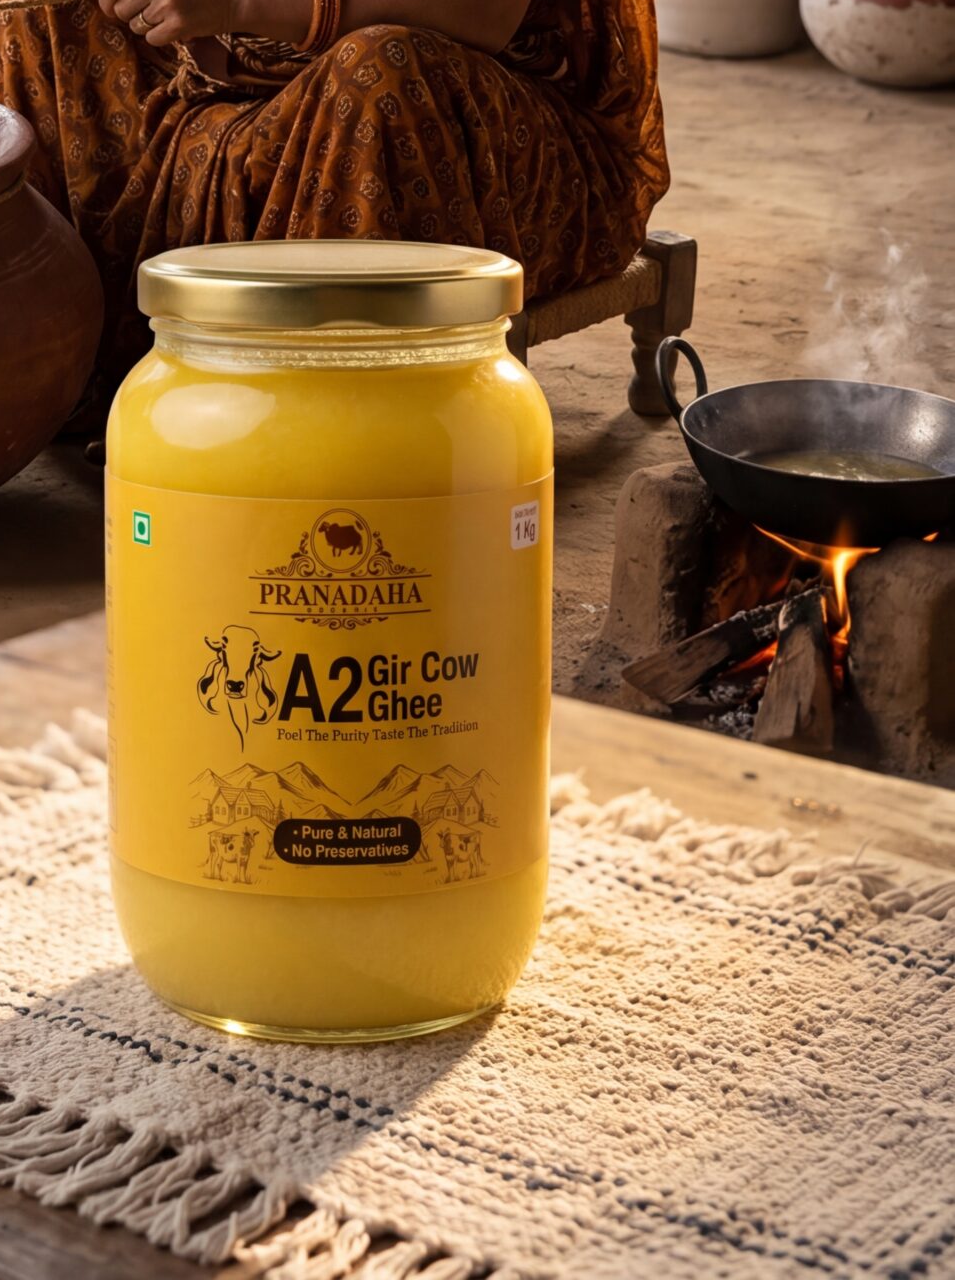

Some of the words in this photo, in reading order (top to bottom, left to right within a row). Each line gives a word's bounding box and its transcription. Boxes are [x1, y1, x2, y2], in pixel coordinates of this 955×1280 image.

[515, 522, 521, 541] 1
[523, 519, 536, 542] Kg
[259, 582, 423, 607] PRANADAHA
[277, 653, 364, 723] A2
[367, 654, 412, 687] Gir
[420, 651, 480, 683] Cow
[367, 690, 443, 722] Ghee
[305, 728, 329, 742] The
[331, 728, 370, 744] Purity
[371, 728, 405, 741] Taste
[407, 725, 429, 738] The
[431, 720, 479, 737] Tradition
[301, 825, 334, 840] Pure
[337, 825, 349, 839] &
[352, 823, 402, 839] Natural
[292, 843, 312, 858] No
[315, 842, 410, 858] Preservatives
